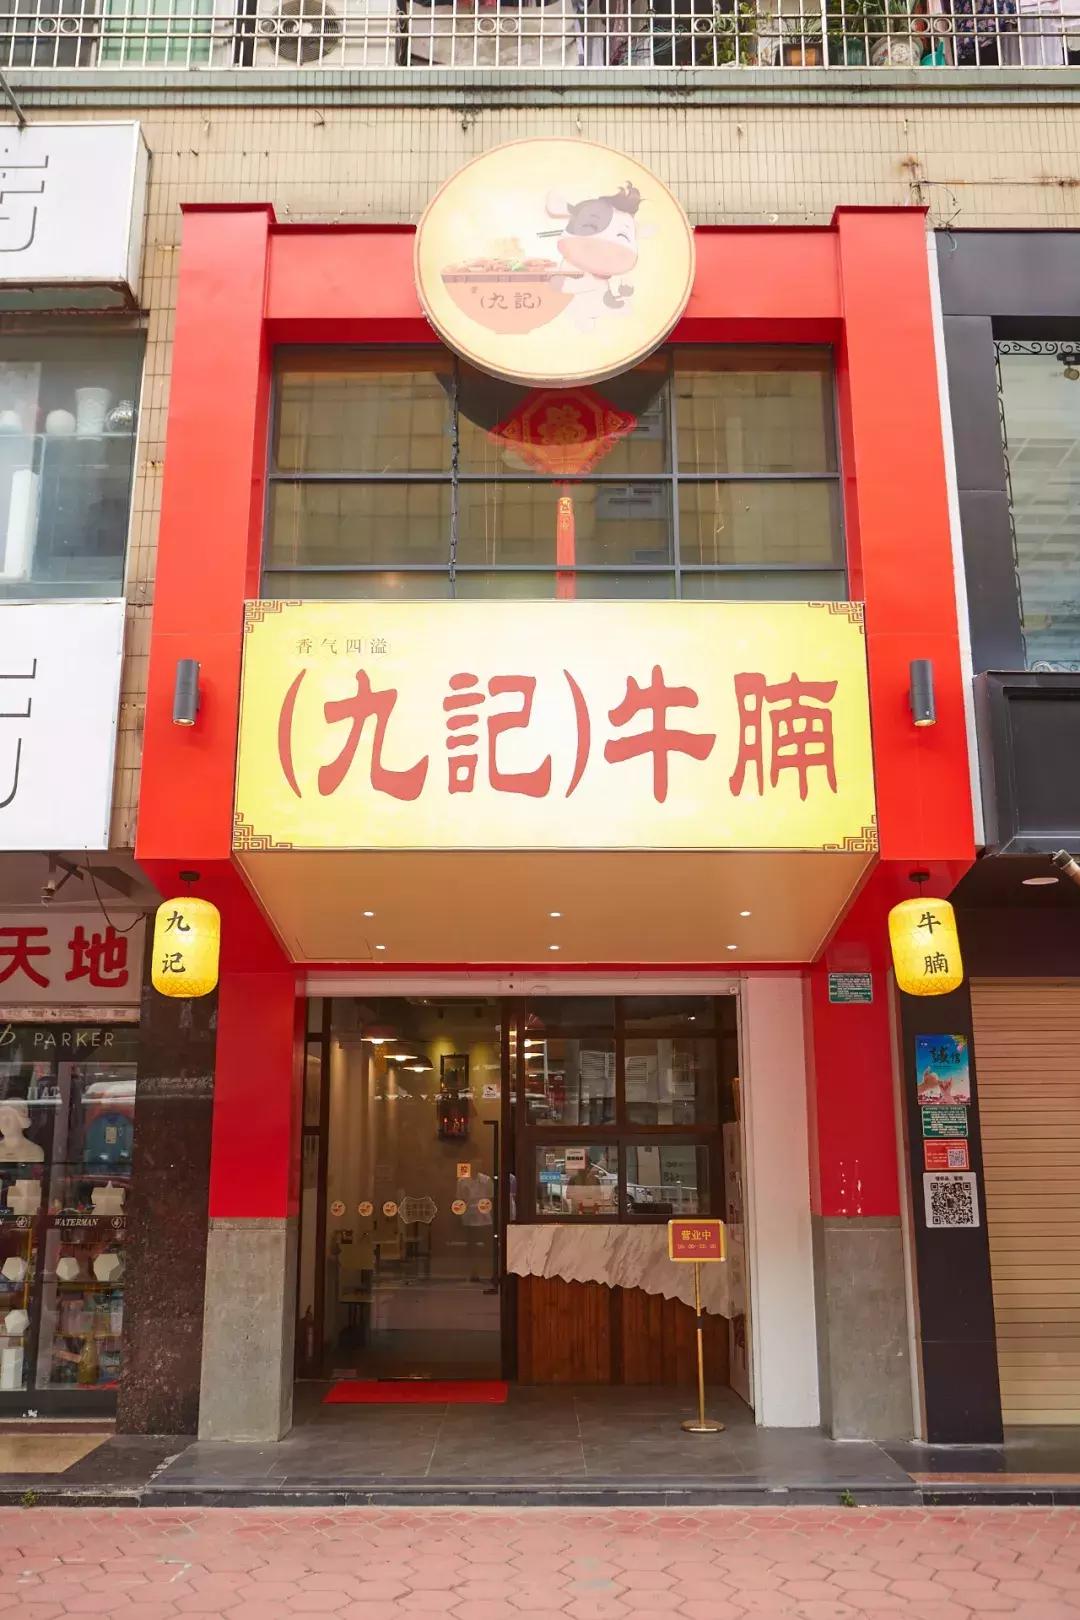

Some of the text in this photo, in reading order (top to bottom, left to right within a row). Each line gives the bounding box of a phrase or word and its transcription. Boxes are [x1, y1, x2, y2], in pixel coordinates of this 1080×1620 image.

[296, 638, 387, 654] 香气四溢
[162, 911, 191, 974] 九记
[916, 911, 949, 976] 牛腩
[0, 926, 129, 988] 天地
[34, 1032, 114, 1047] PARKER
[54, 1218, 99, 1227] WATERMAN
[681, 1229, 711, 1241] 营业中
